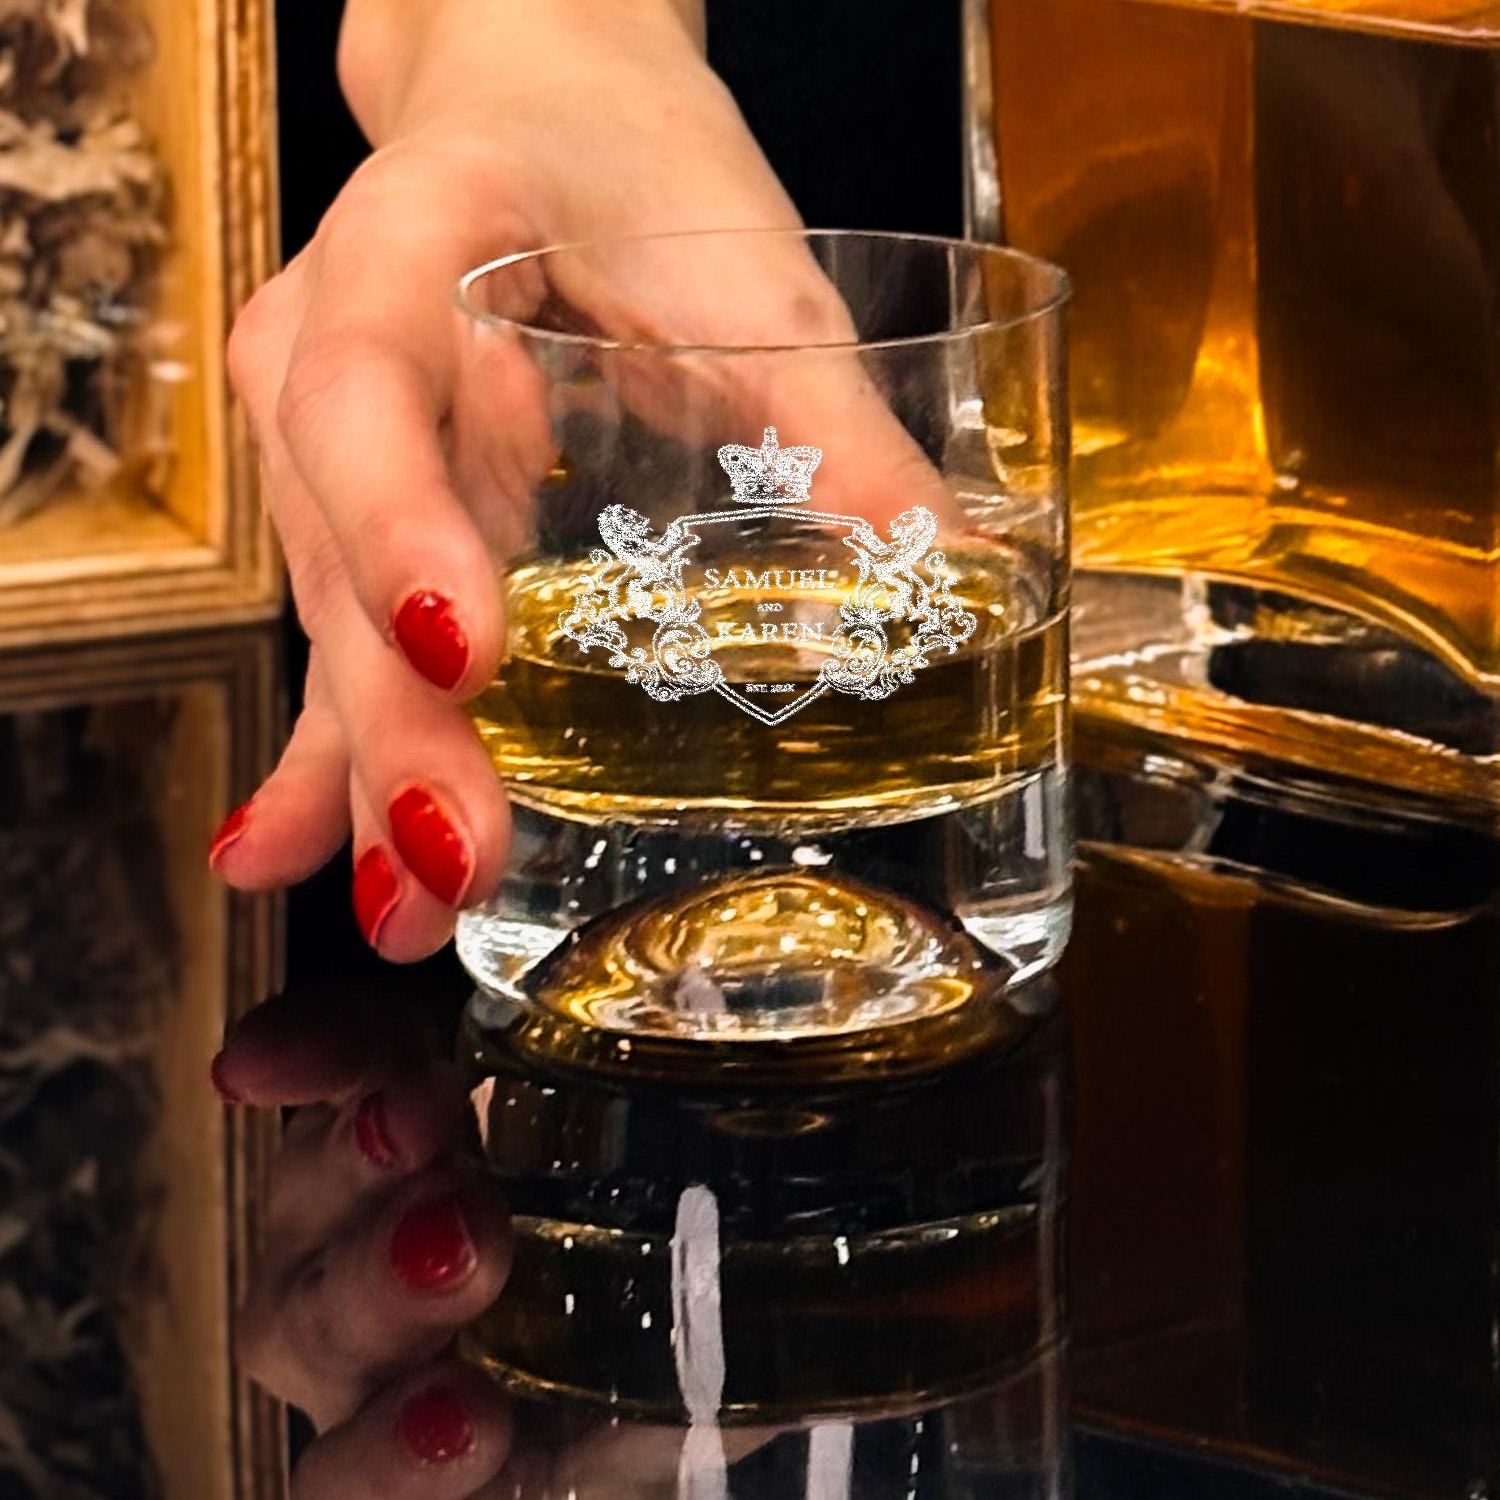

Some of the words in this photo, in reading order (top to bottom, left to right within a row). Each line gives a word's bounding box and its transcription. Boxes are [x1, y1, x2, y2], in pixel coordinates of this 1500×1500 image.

[704, 568, 836, 590] SAMUEL
[757, 602, 784, 613] AND
[715, 621, 825, 644] KAREN
